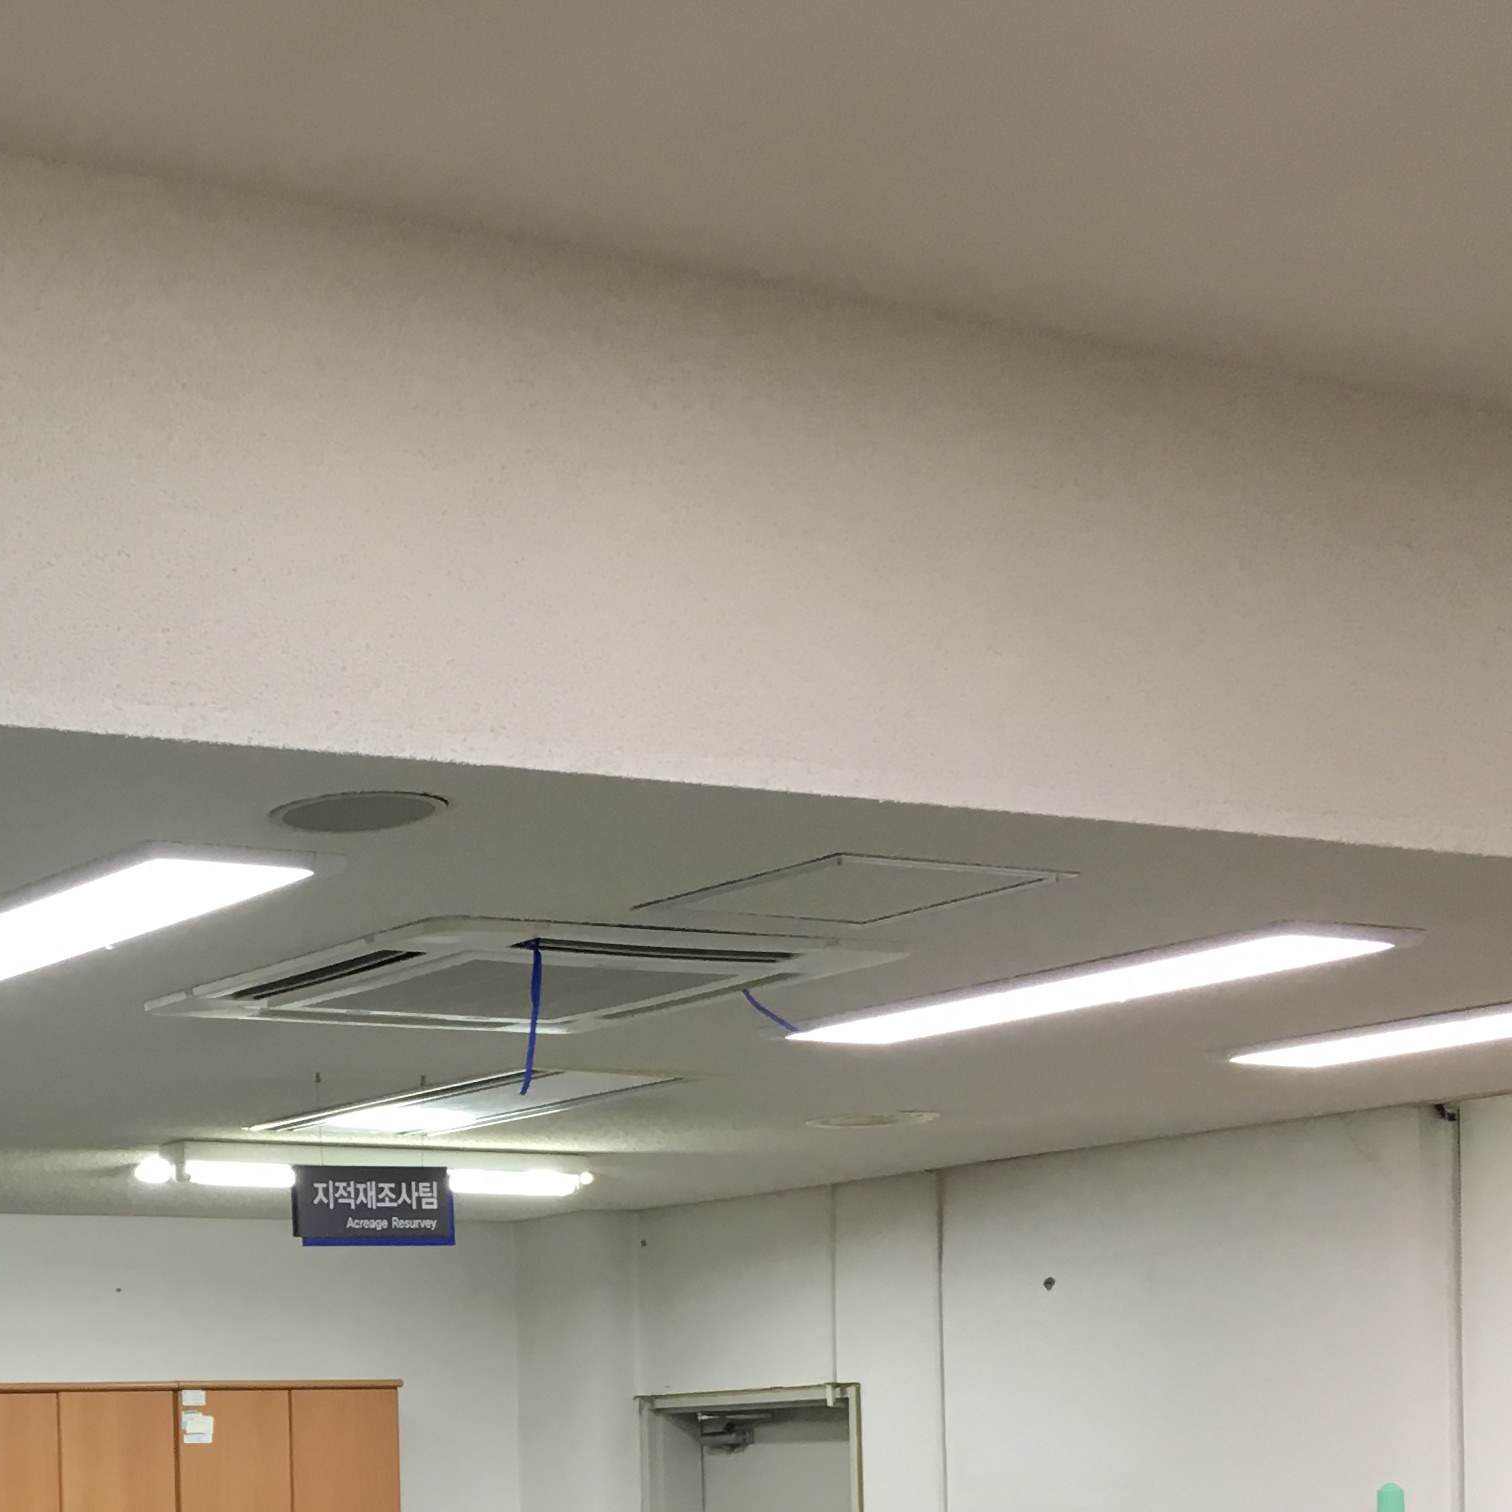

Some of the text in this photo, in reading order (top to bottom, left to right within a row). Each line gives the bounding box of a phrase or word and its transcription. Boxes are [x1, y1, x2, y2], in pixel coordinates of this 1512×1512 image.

[312, 1179, 439, 1210] 지적재조사팀
[346, 1216, 438, 1231] Acreage Resurvey
